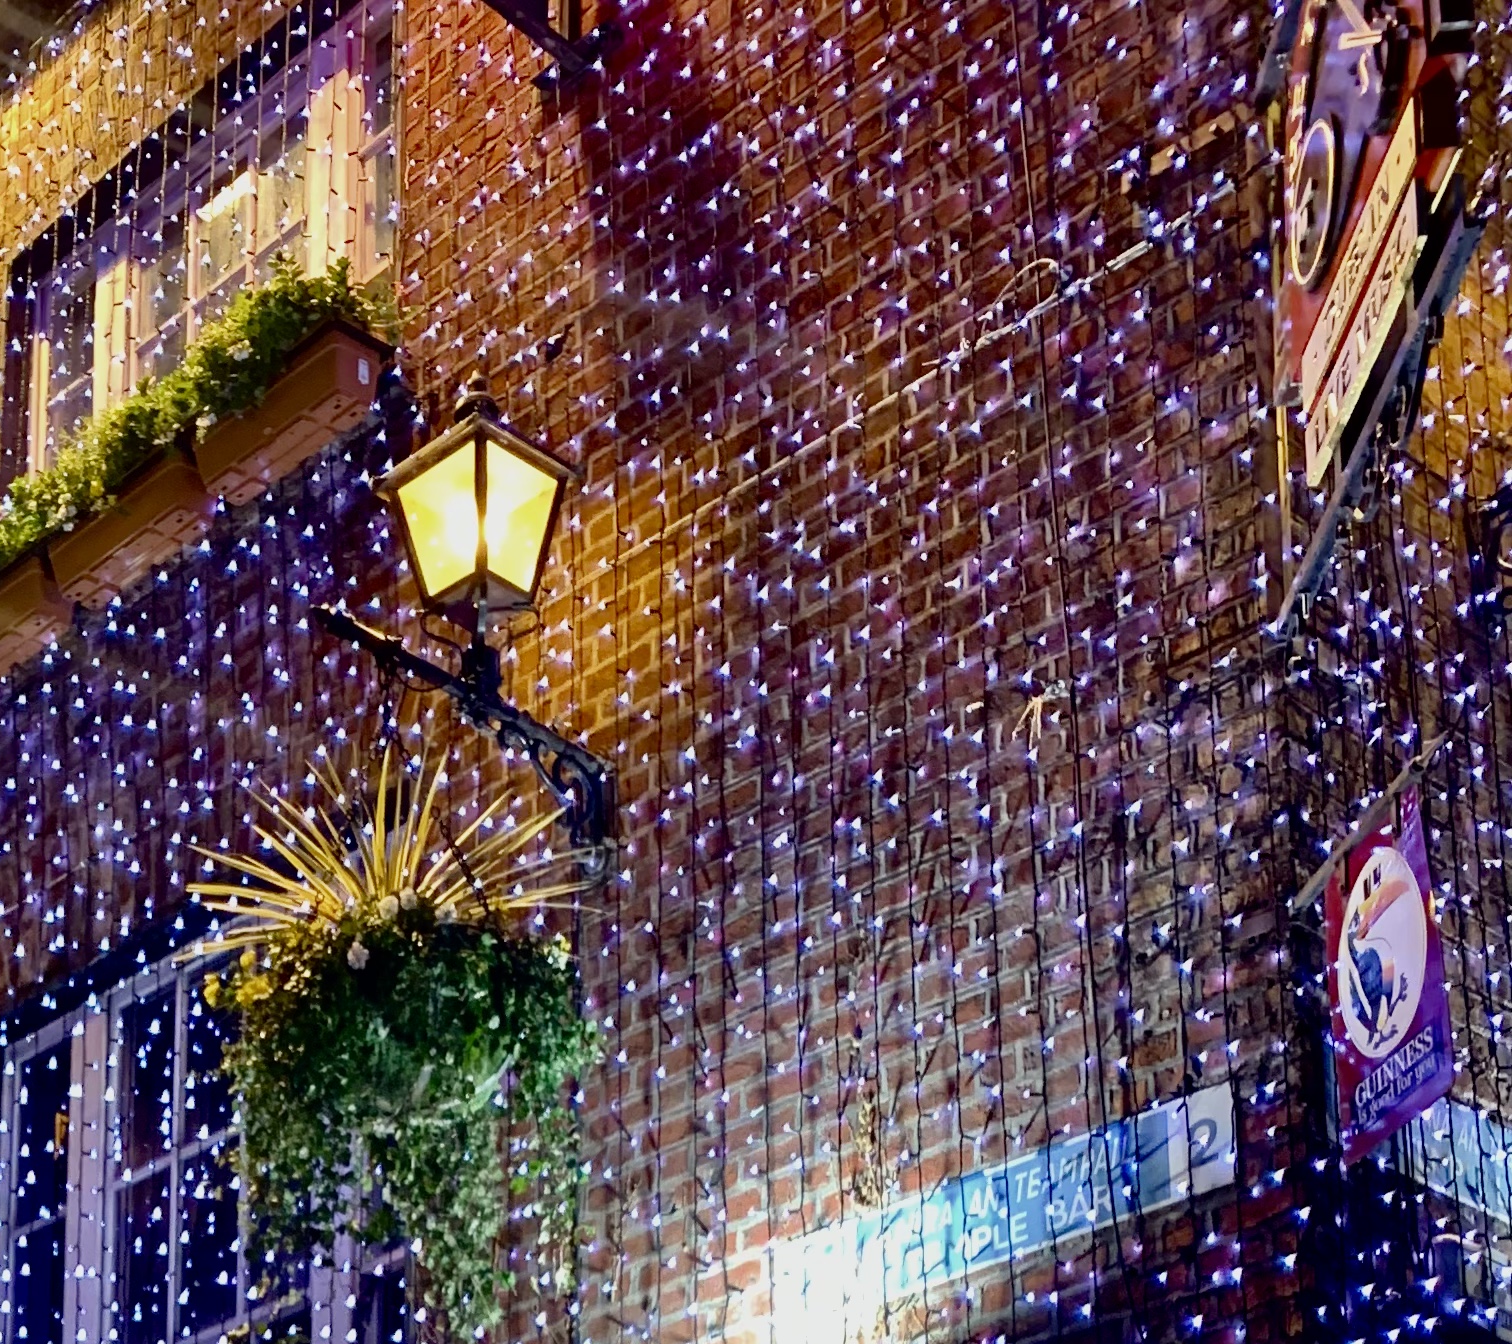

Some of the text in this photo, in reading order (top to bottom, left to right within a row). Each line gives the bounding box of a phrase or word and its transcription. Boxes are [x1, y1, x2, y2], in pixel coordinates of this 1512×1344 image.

[1355, 1026, 1433, 1107] GUINNESS
[1396, 1072, 1412, 1096] for
[1415, 1054, 1436, 1086] you
[1015, 1130, 1132, 1200] TEAMPAI
[1191, 1117, 1219, 1168] 2
[1046, 1185, 1112, 1232] BAR
